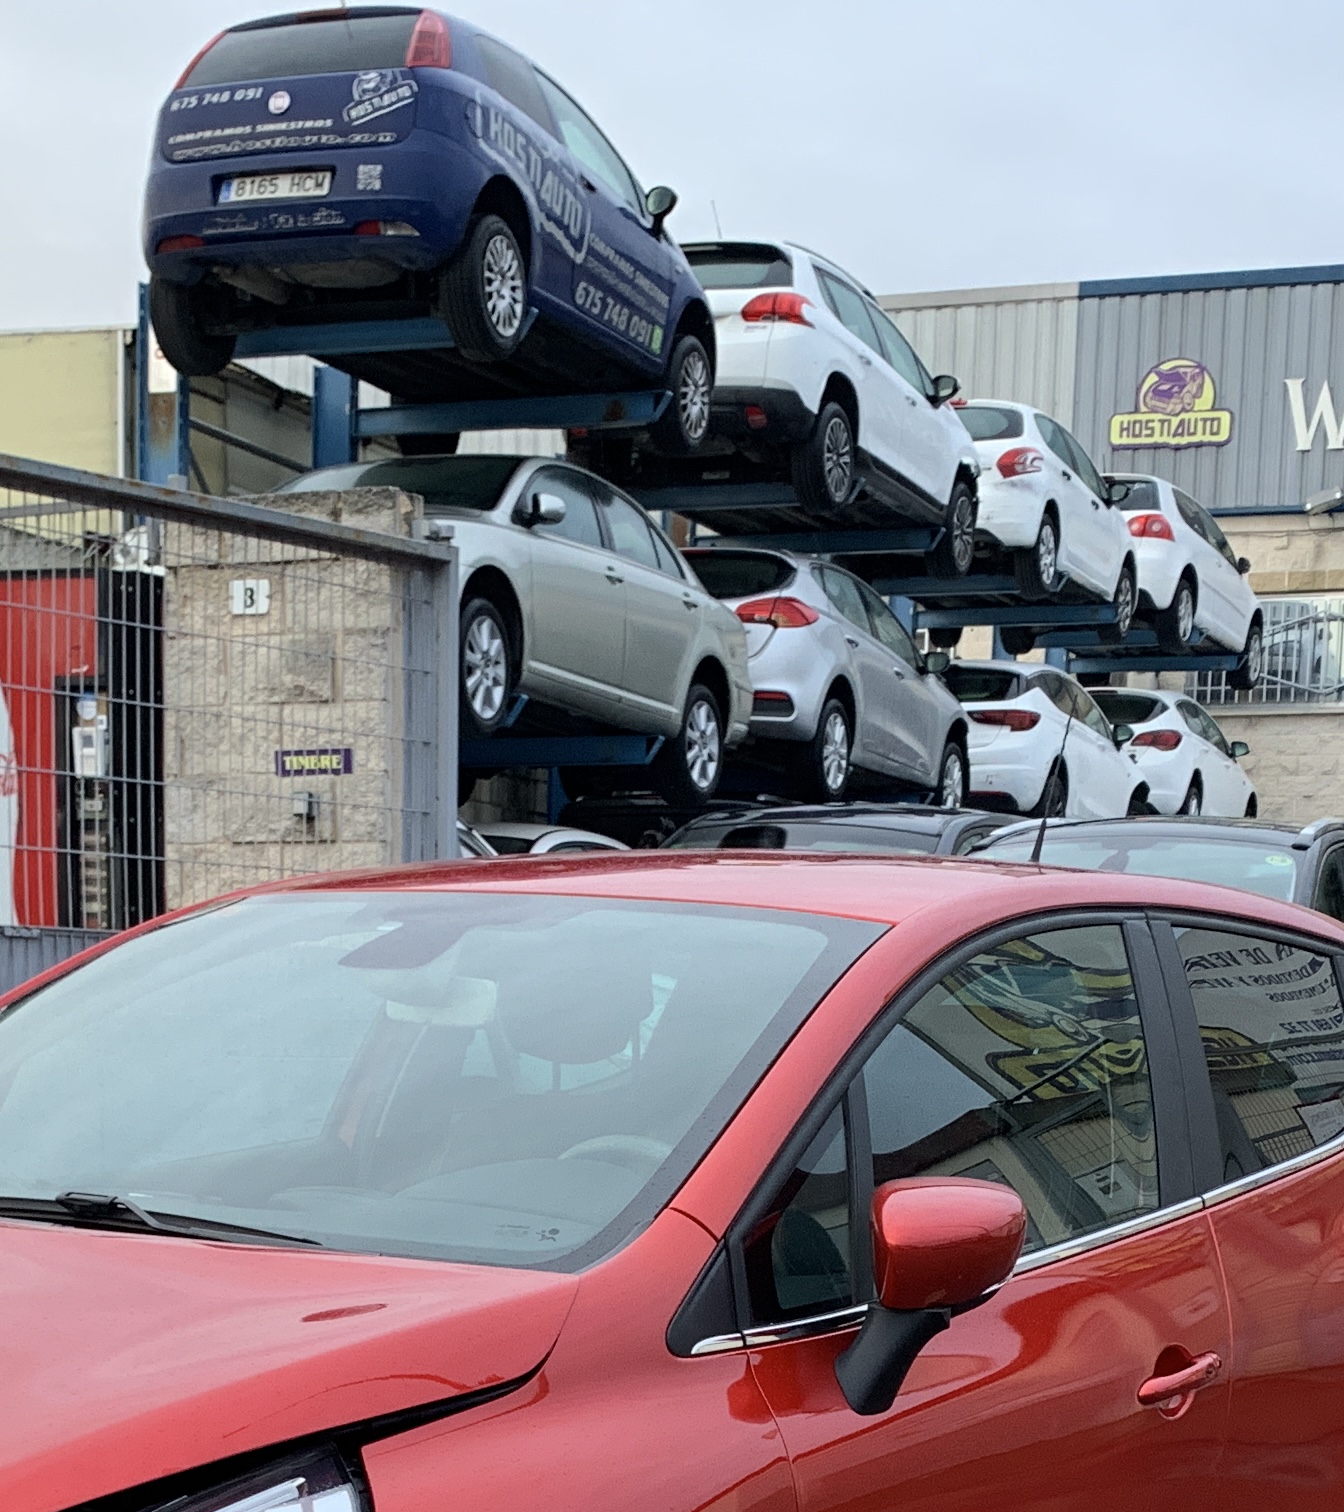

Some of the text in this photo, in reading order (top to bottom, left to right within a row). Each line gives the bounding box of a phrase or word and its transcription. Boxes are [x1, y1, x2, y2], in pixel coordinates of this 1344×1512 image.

[233, 87, 264, 101] 091
[234, 171, 328, 198] 8165 HCW
[574, 281, 604, 315] 675
[603, 296, 630, 331] 748
[628, 315, 653, 347] 091
[1118, 417, 1222, 439] HOSTIAUTO
[283, 754, 342, 771] TIMBRE
